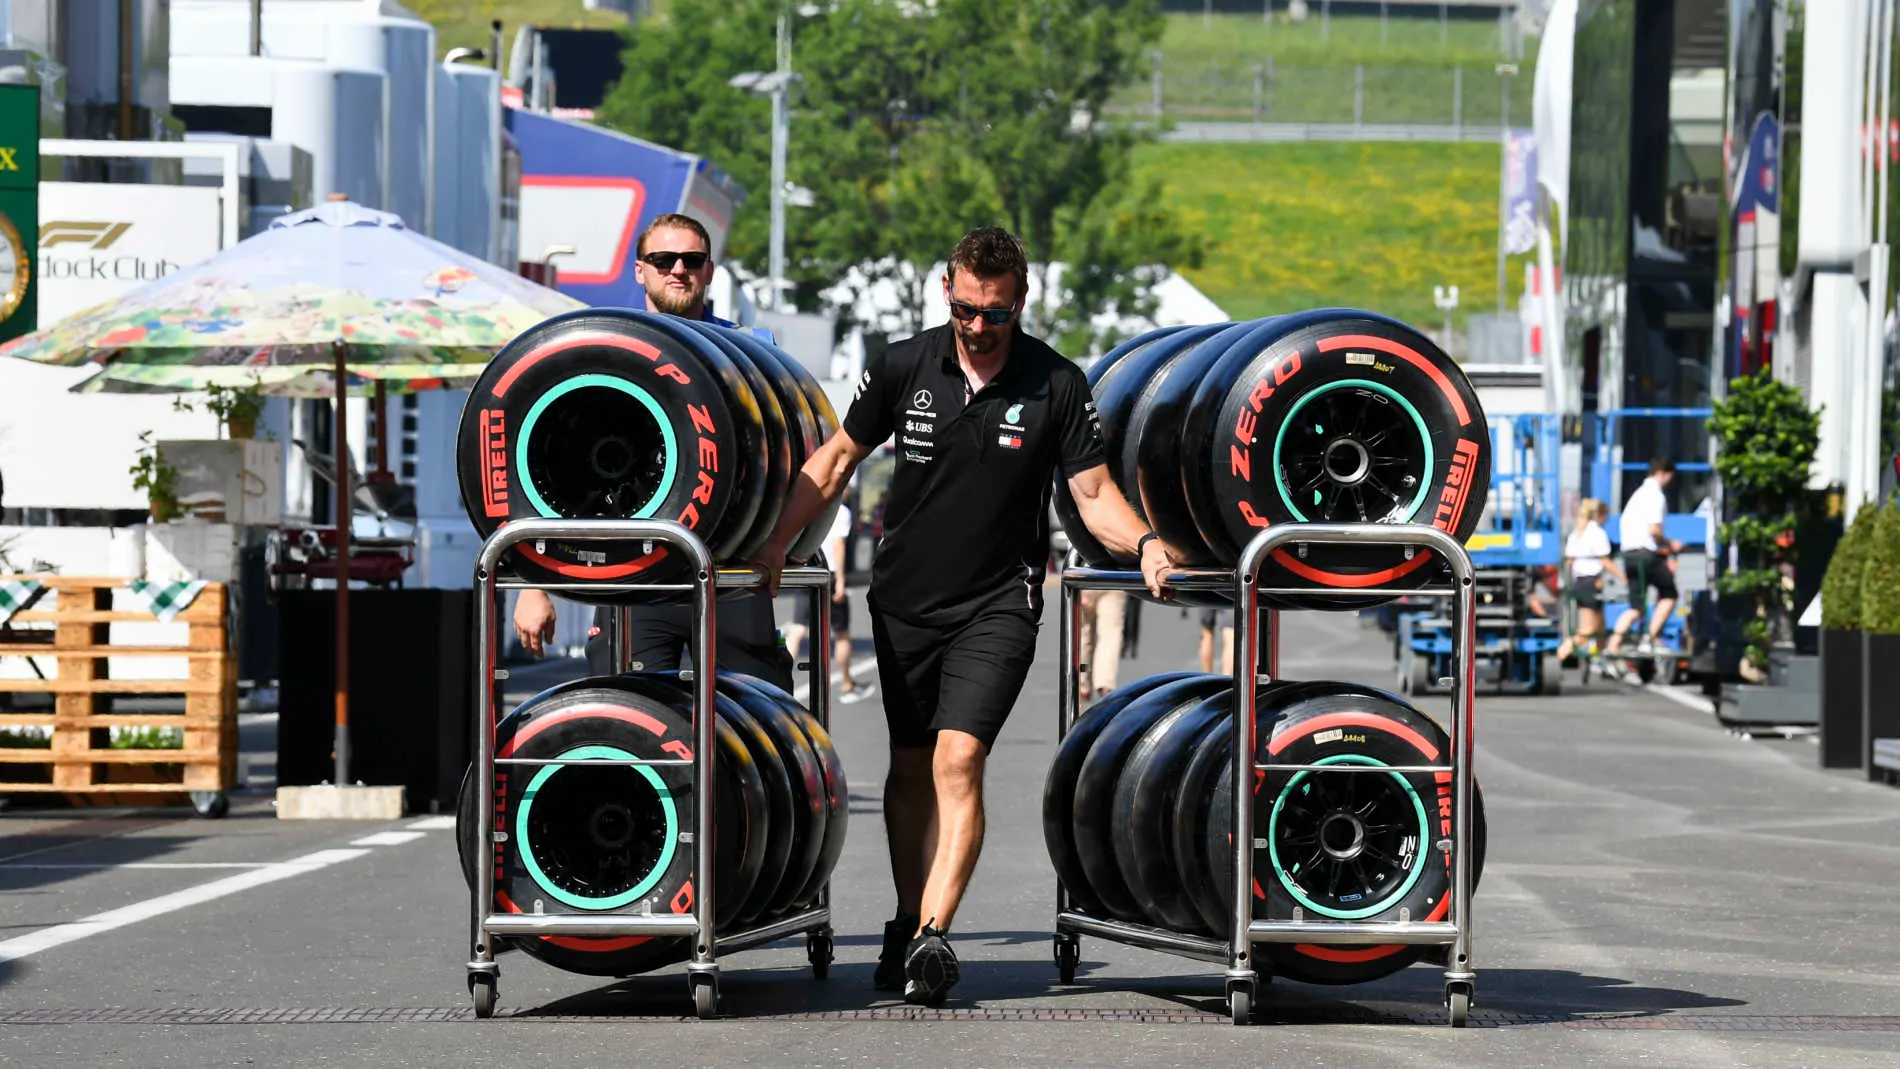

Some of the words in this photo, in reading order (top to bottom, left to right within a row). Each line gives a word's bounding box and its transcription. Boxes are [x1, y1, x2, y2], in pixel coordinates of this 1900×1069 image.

[655, 362, 691, 385] P
[1230, 350, 1303, 482] ZERO
[479, 408, 510, 517] PIRELLI
[915, 422, 934, 433] UBS
[1432, 438, 1480, 536] PIRELL
